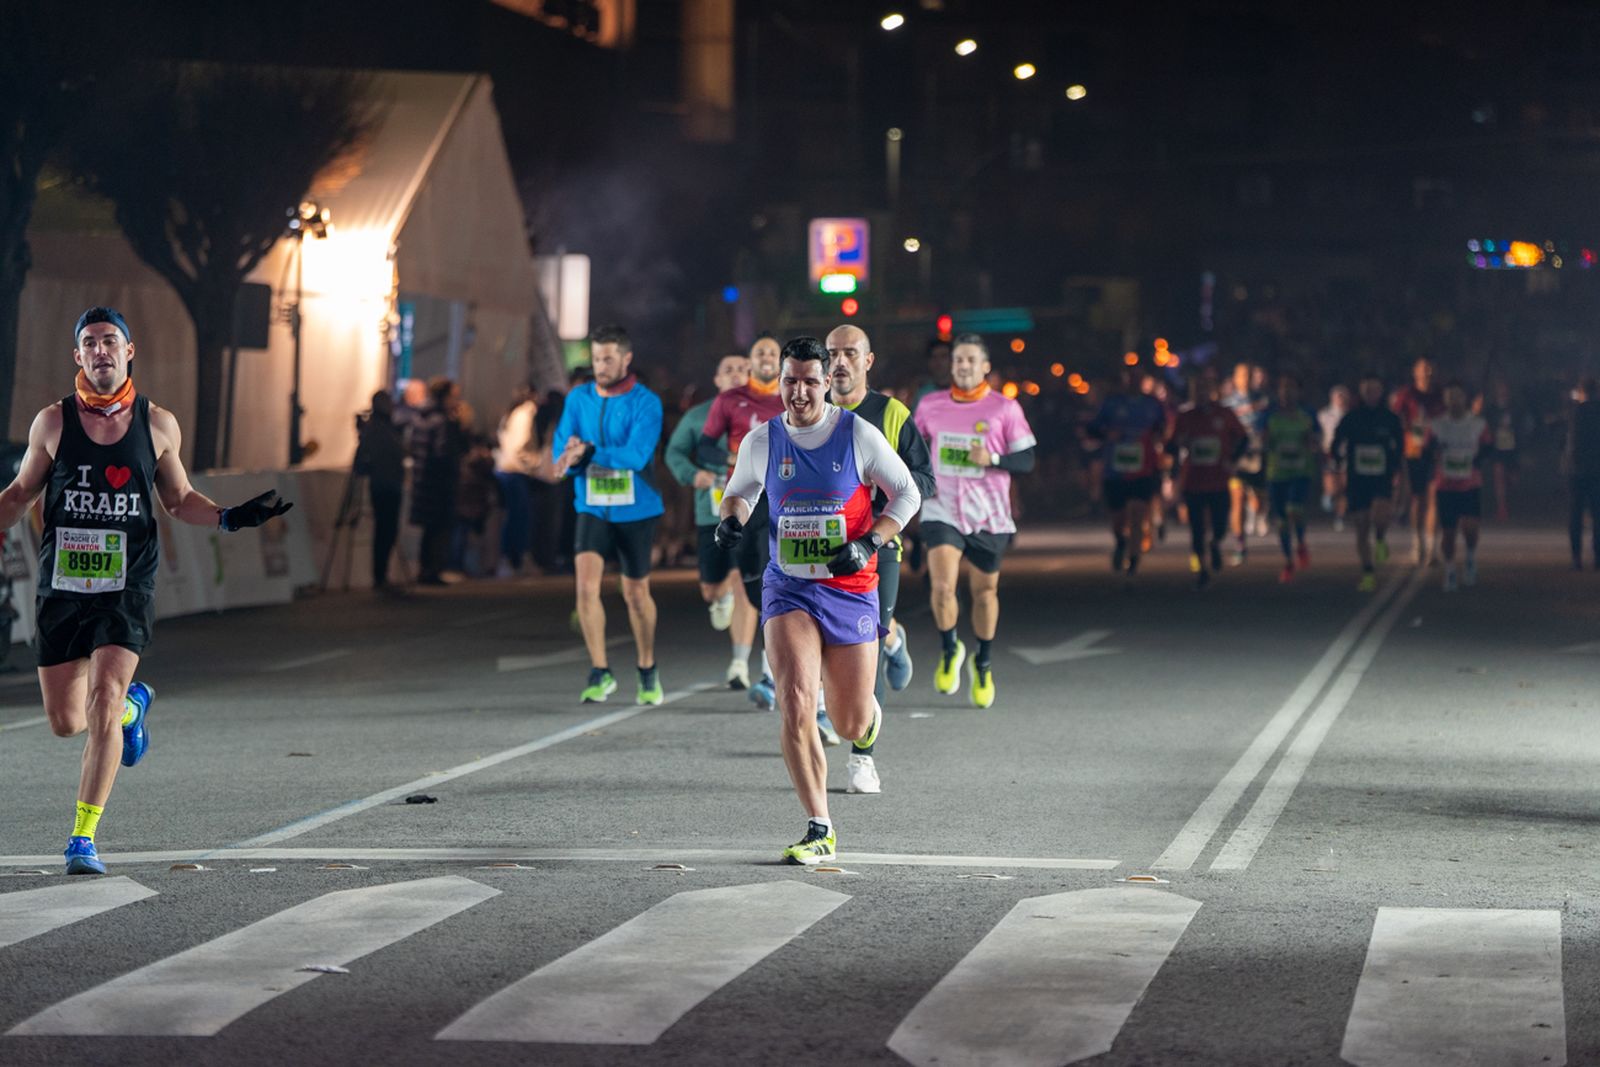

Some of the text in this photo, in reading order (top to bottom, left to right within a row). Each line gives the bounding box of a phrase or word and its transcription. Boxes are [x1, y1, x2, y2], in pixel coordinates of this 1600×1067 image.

[77, 465, 92, 487] I
[64, 489, 140, 516] KRABI
[784, 530, 797, 538] SAN
[792, 538, 830, 557] 7143
[68, 552, 112, 571] 8997
